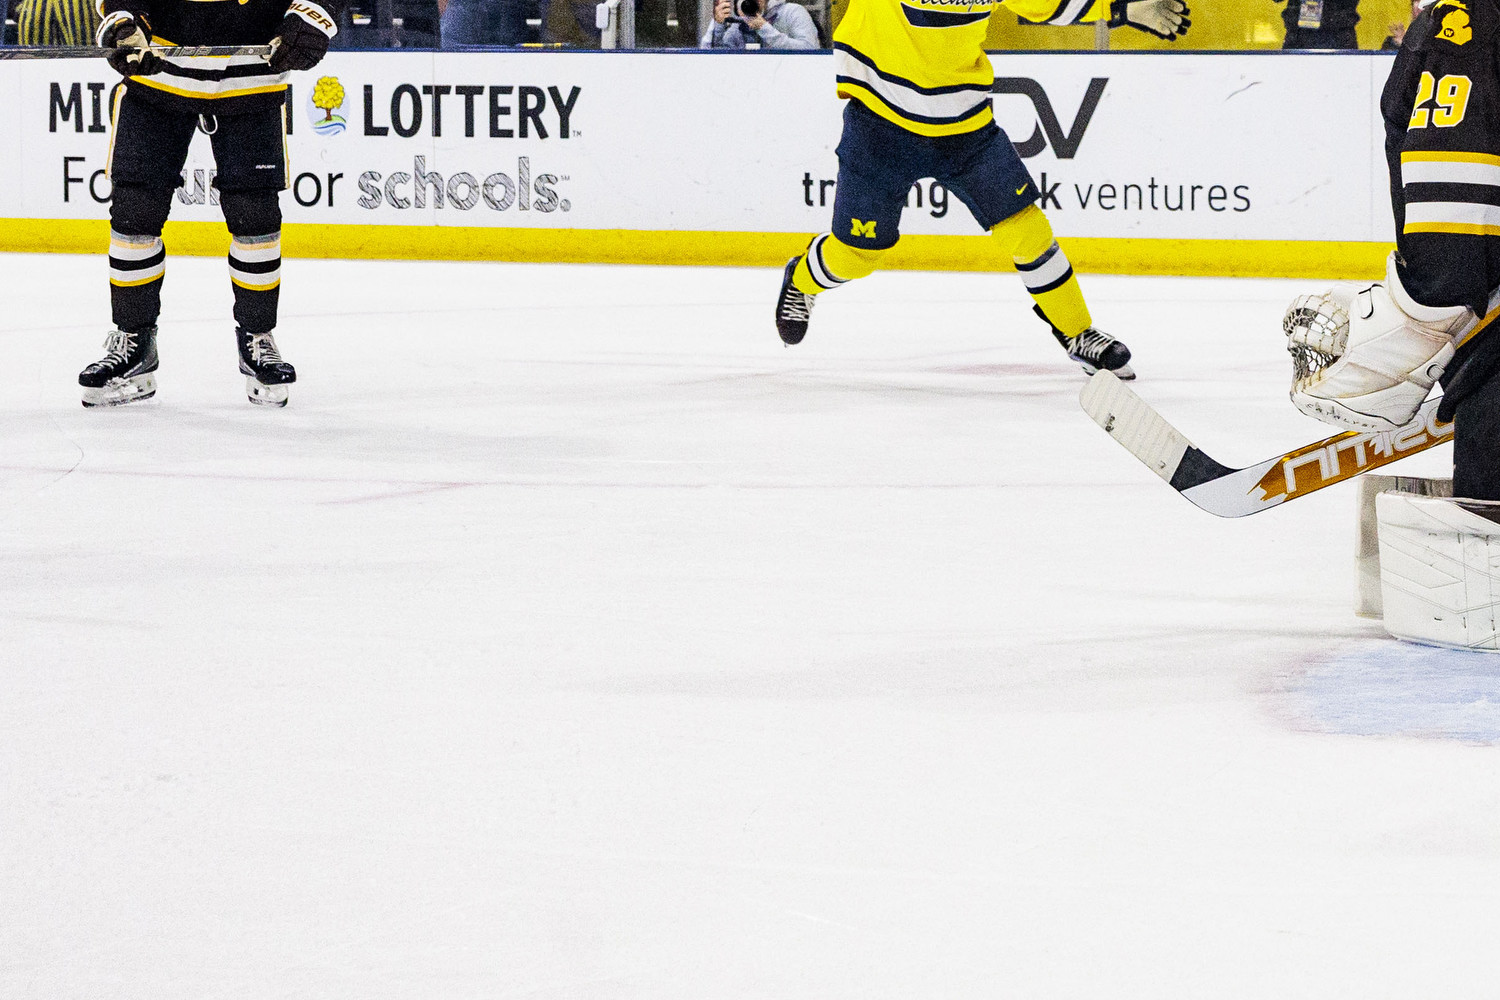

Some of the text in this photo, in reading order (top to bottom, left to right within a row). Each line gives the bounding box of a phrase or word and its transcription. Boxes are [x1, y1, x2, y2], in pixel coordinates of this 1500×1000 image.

[1407, 70, 1473, 132] 29
[802, 172, 949, 219] trng
[1074, 176, 1251, 213] ventures
[850, 217, 877, 239] M
